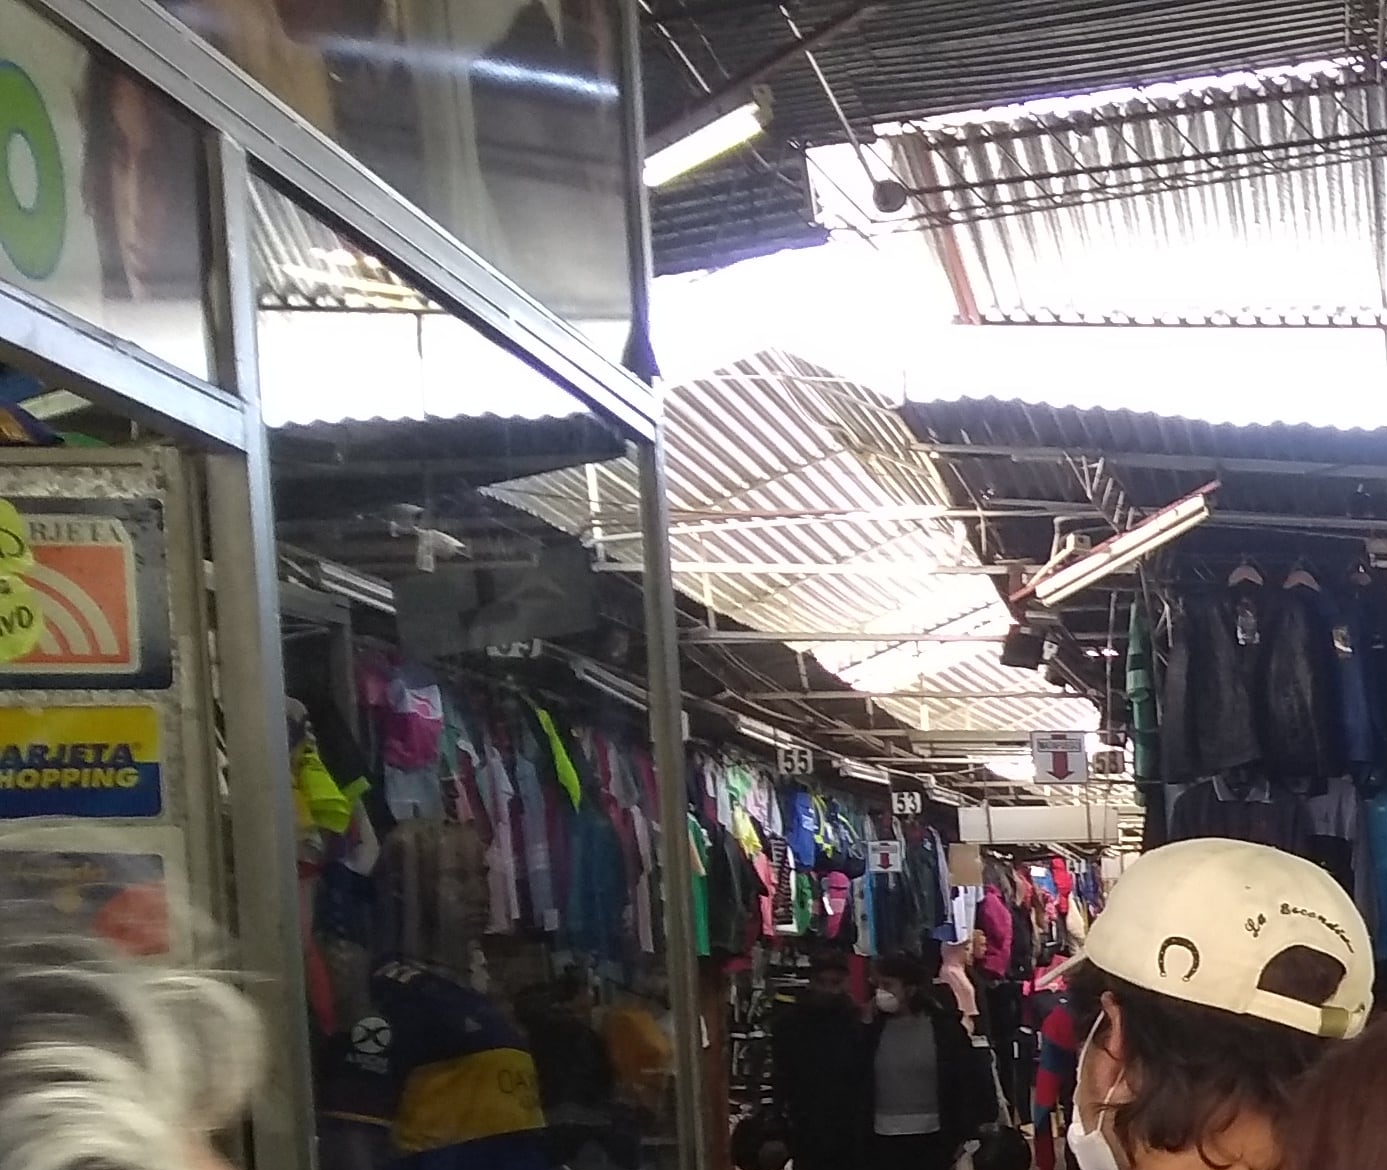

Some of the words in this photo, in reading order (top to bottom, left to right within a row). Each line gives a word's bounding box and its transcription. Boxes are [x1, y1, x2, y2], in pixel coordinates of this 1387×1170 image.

[29, 521, 122, 542] RJETA
[0, 743, 134, 768] ARJETA
[783, 750, 809, 774] 55
[0, 767, 139, 789] HOPPING
[896, 793, 918, 812] 53
